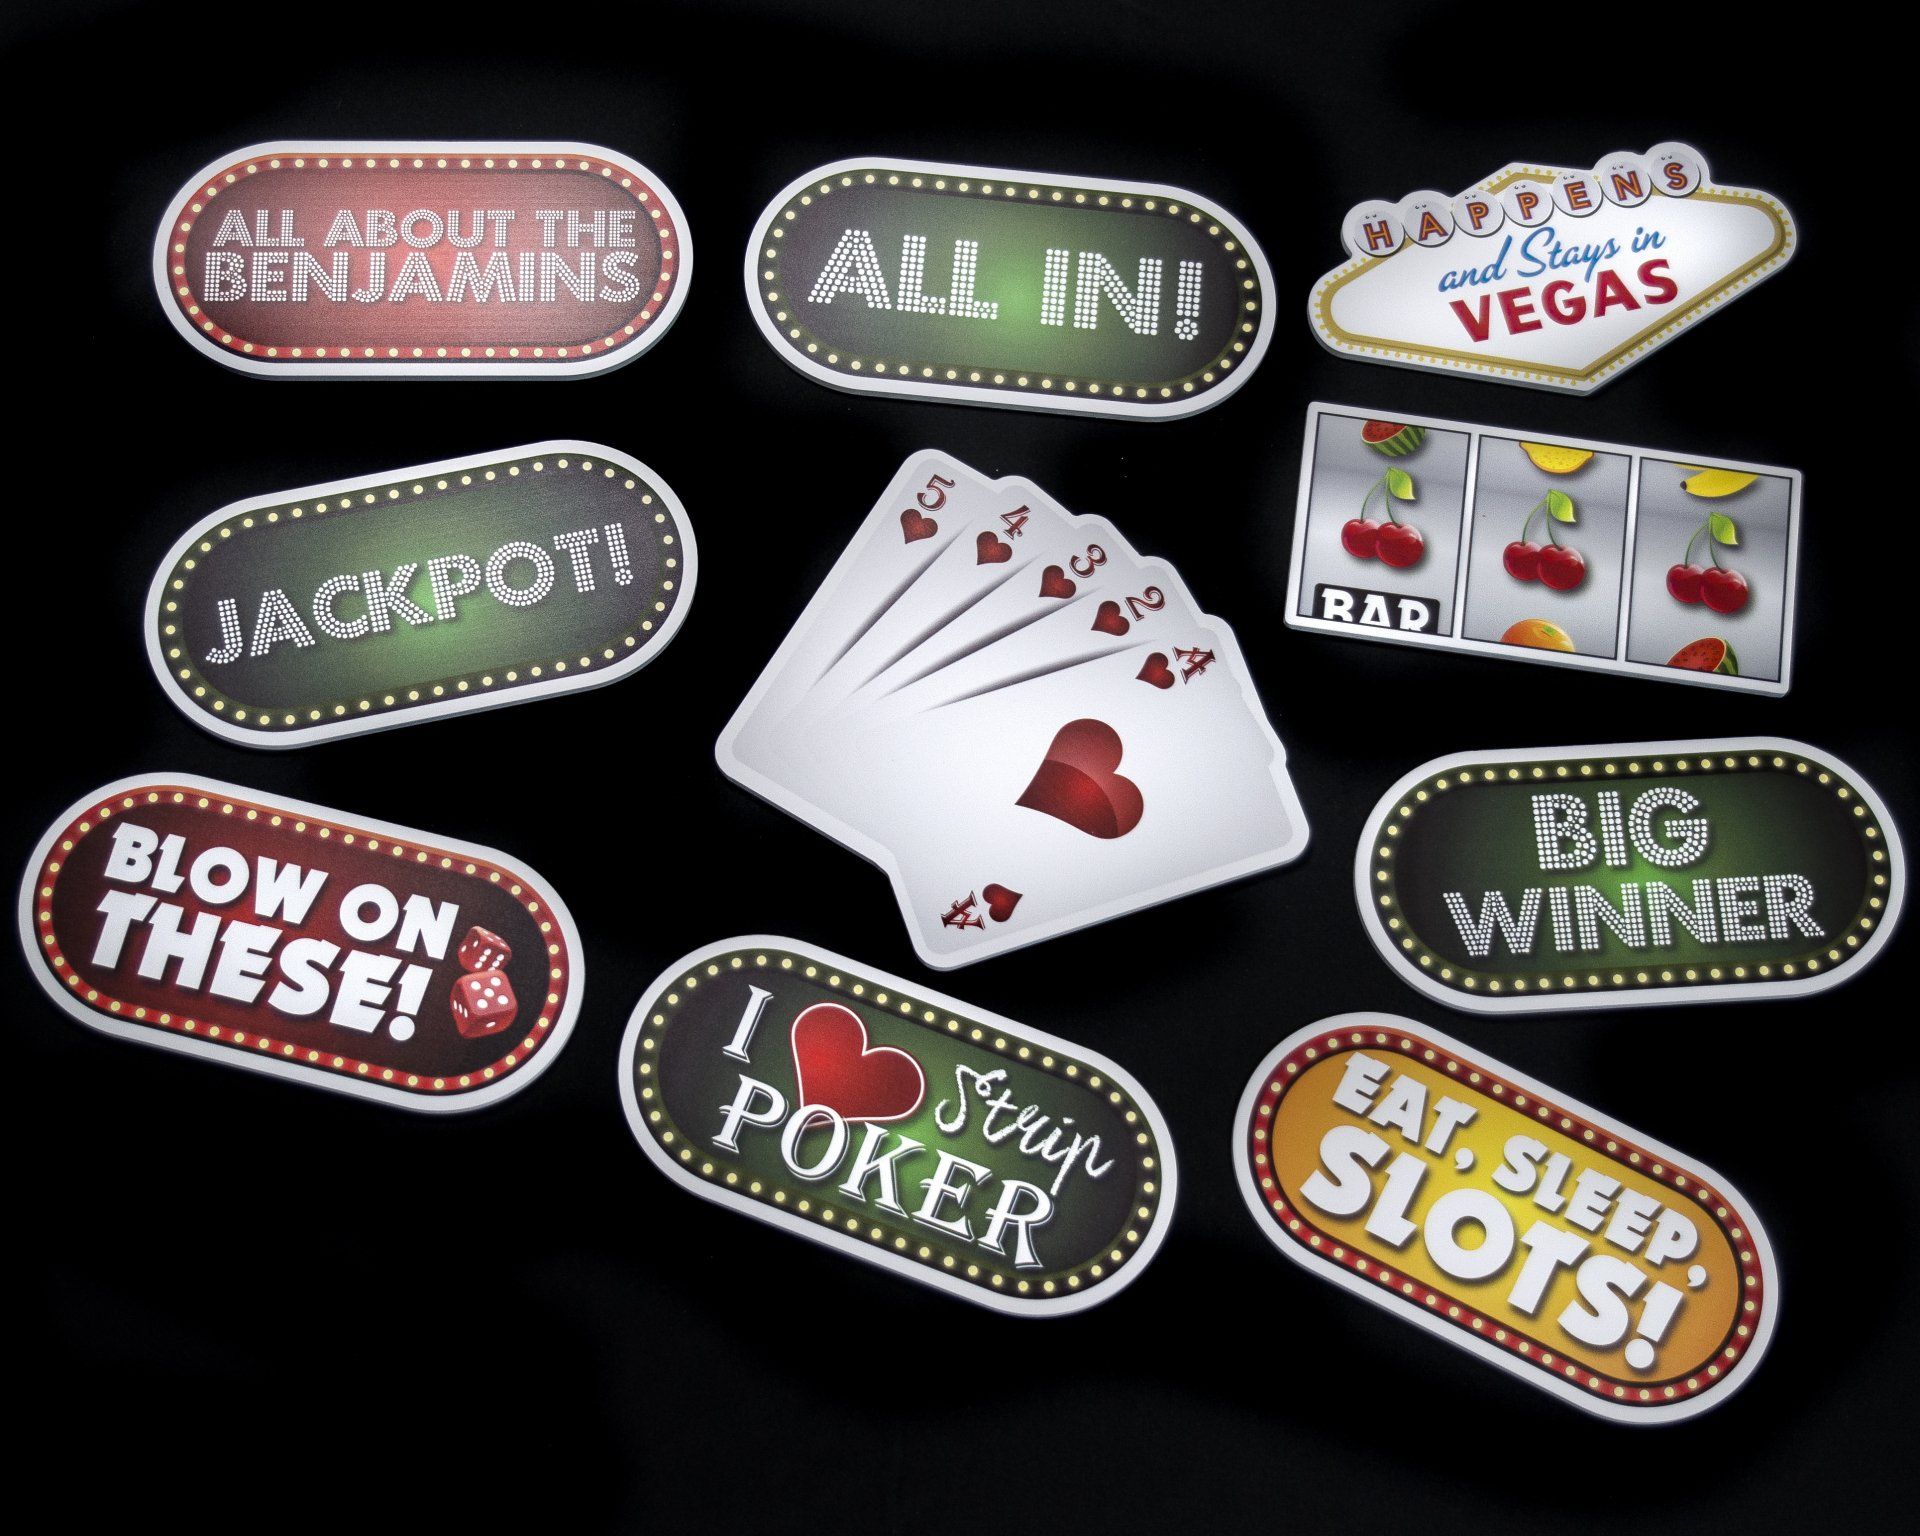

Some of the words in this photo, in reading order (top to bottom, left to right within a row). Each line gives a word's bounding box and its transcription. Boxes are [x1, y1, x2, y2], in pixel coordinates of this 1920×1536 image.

[213, 209, 304, 247] ALL
[324, 208, 515, 248] ABOUT
[536, 210, 636, 247] THE
[1362, 162, 1689, 251] HAPPENS
[204, 251, 640, 303] BENJAMINS
[808, 229, 998, 320] ALL
[1040, 248, 1203, 341] IN!
[1438, 234, 1513, 292] and
[1517, 227, 1621, 283] Stays
[1630, 226, 1667, 258] in
[1449, 258, 1679, 342] VEGAS
[917, 473, 955, 511] 5
[1000, 504, 1031, 541] 4
[205, 522, 634, 664] JACKPOT!
[1069, 543, 1107, 578] 3
[1125, 585, 1165, 621] 2
[1172, 646, 1216, 685] A
[1531, 786, 1708, 870] BIG
[103, 821, 329, 924] BLOW
[339, 883, 460, 960] ON
[940, 890, 986, 930] A
[1443, 873, 1825, 956] WINNER
[91, 889, 433, 1042] THESE!
[722, 984, 774, 1063] I
[935, 1064, 1115, 1196] Strip
[712, 1073, 1055, 1269] POKER
[1332, 1051, 1478, 1171] EAT,
[1491, 1134, 1708, 1288] SLEEP,
[1300, 1124, 1684, 1370] SLOTS!
